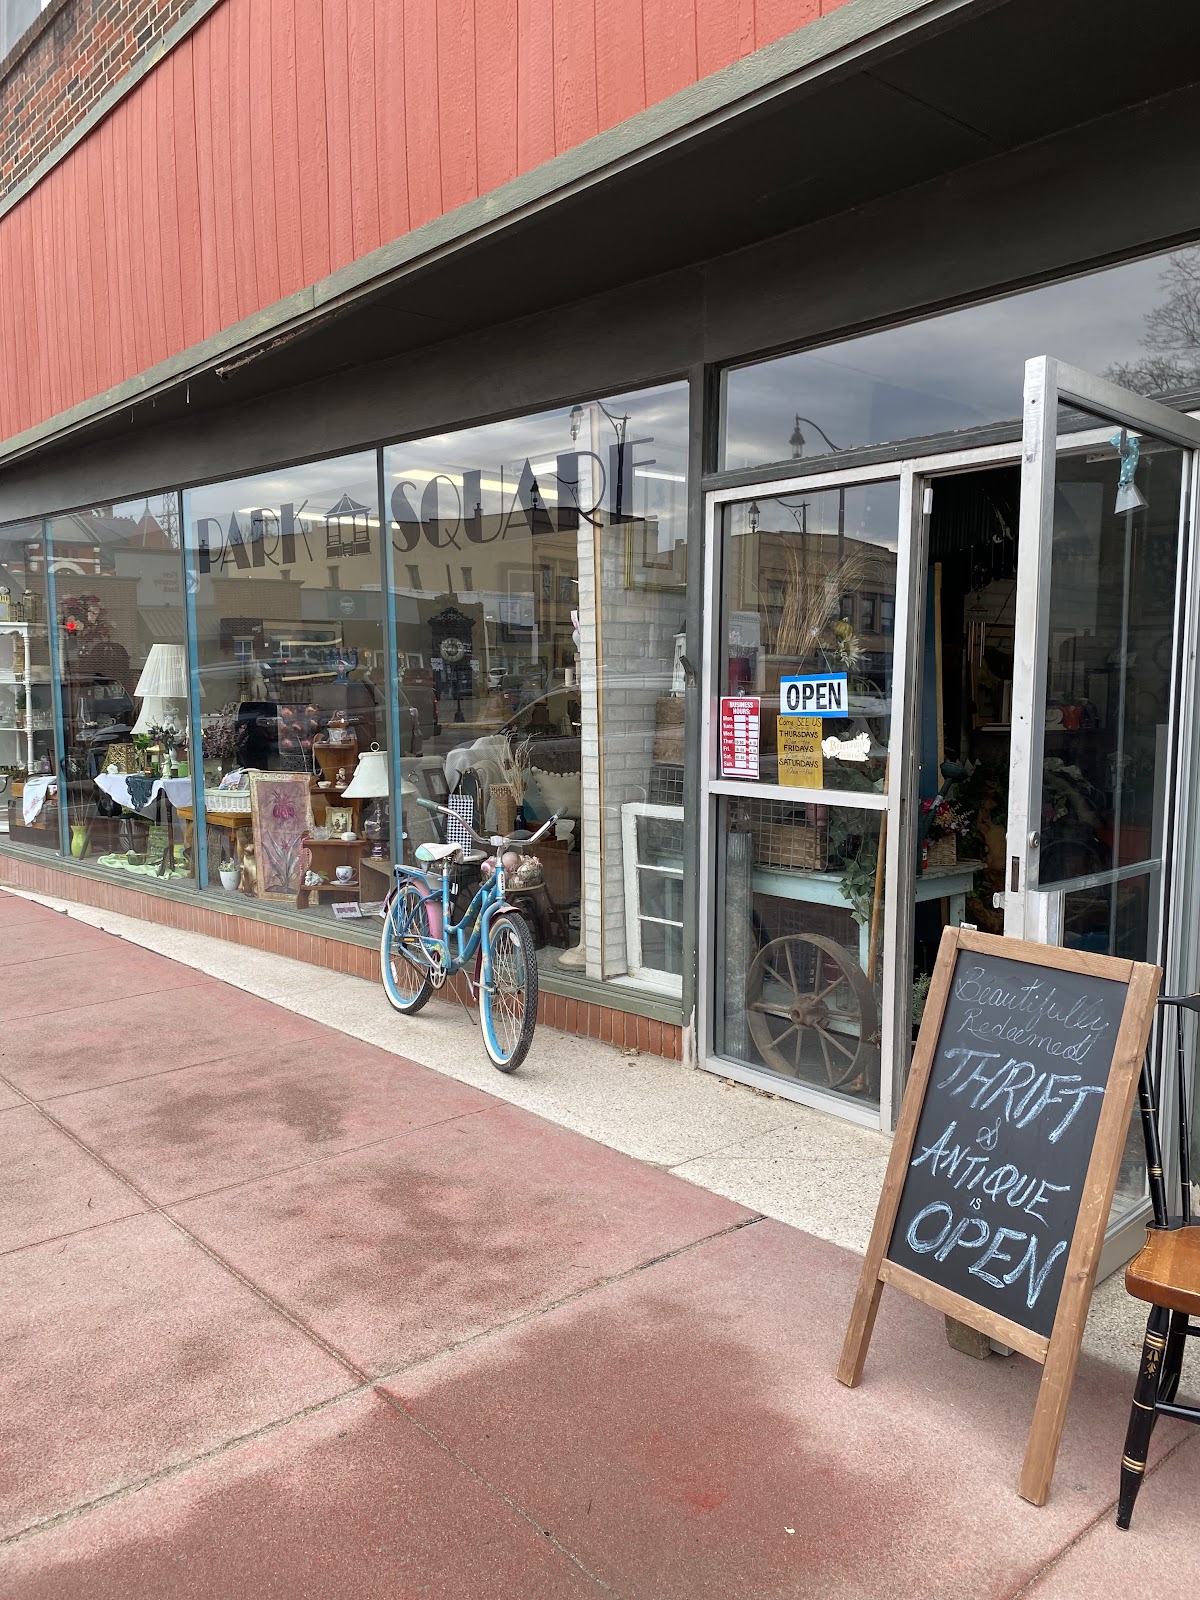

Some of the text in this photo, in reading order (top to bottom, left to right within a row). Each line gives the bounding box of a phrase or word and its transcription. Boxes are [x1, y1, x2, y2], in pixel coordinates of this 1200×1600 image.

[198, 437, 658, 573] PARK SQUARE
[729, 701, 754, 709] BUSINESS
[786, 682, 842, 710] OPEN
[779, 717, 821, 727] Come SEE US
[779, 730, 818, 738] THURSDAYS
[779, 758, 819, 768] SATURDAYS
[783, 744, 814, 753] FRIDAYS
[955, 966, 1110, 1031] Beautifully
[957, 1009, 1097, 1065] Redeemed
[937, 1048, 1106, 1143] THRIFT
[911, 1120, 1071, 1228] ANTIQUE
[906, 1200, 1068, 1309] OPEN
